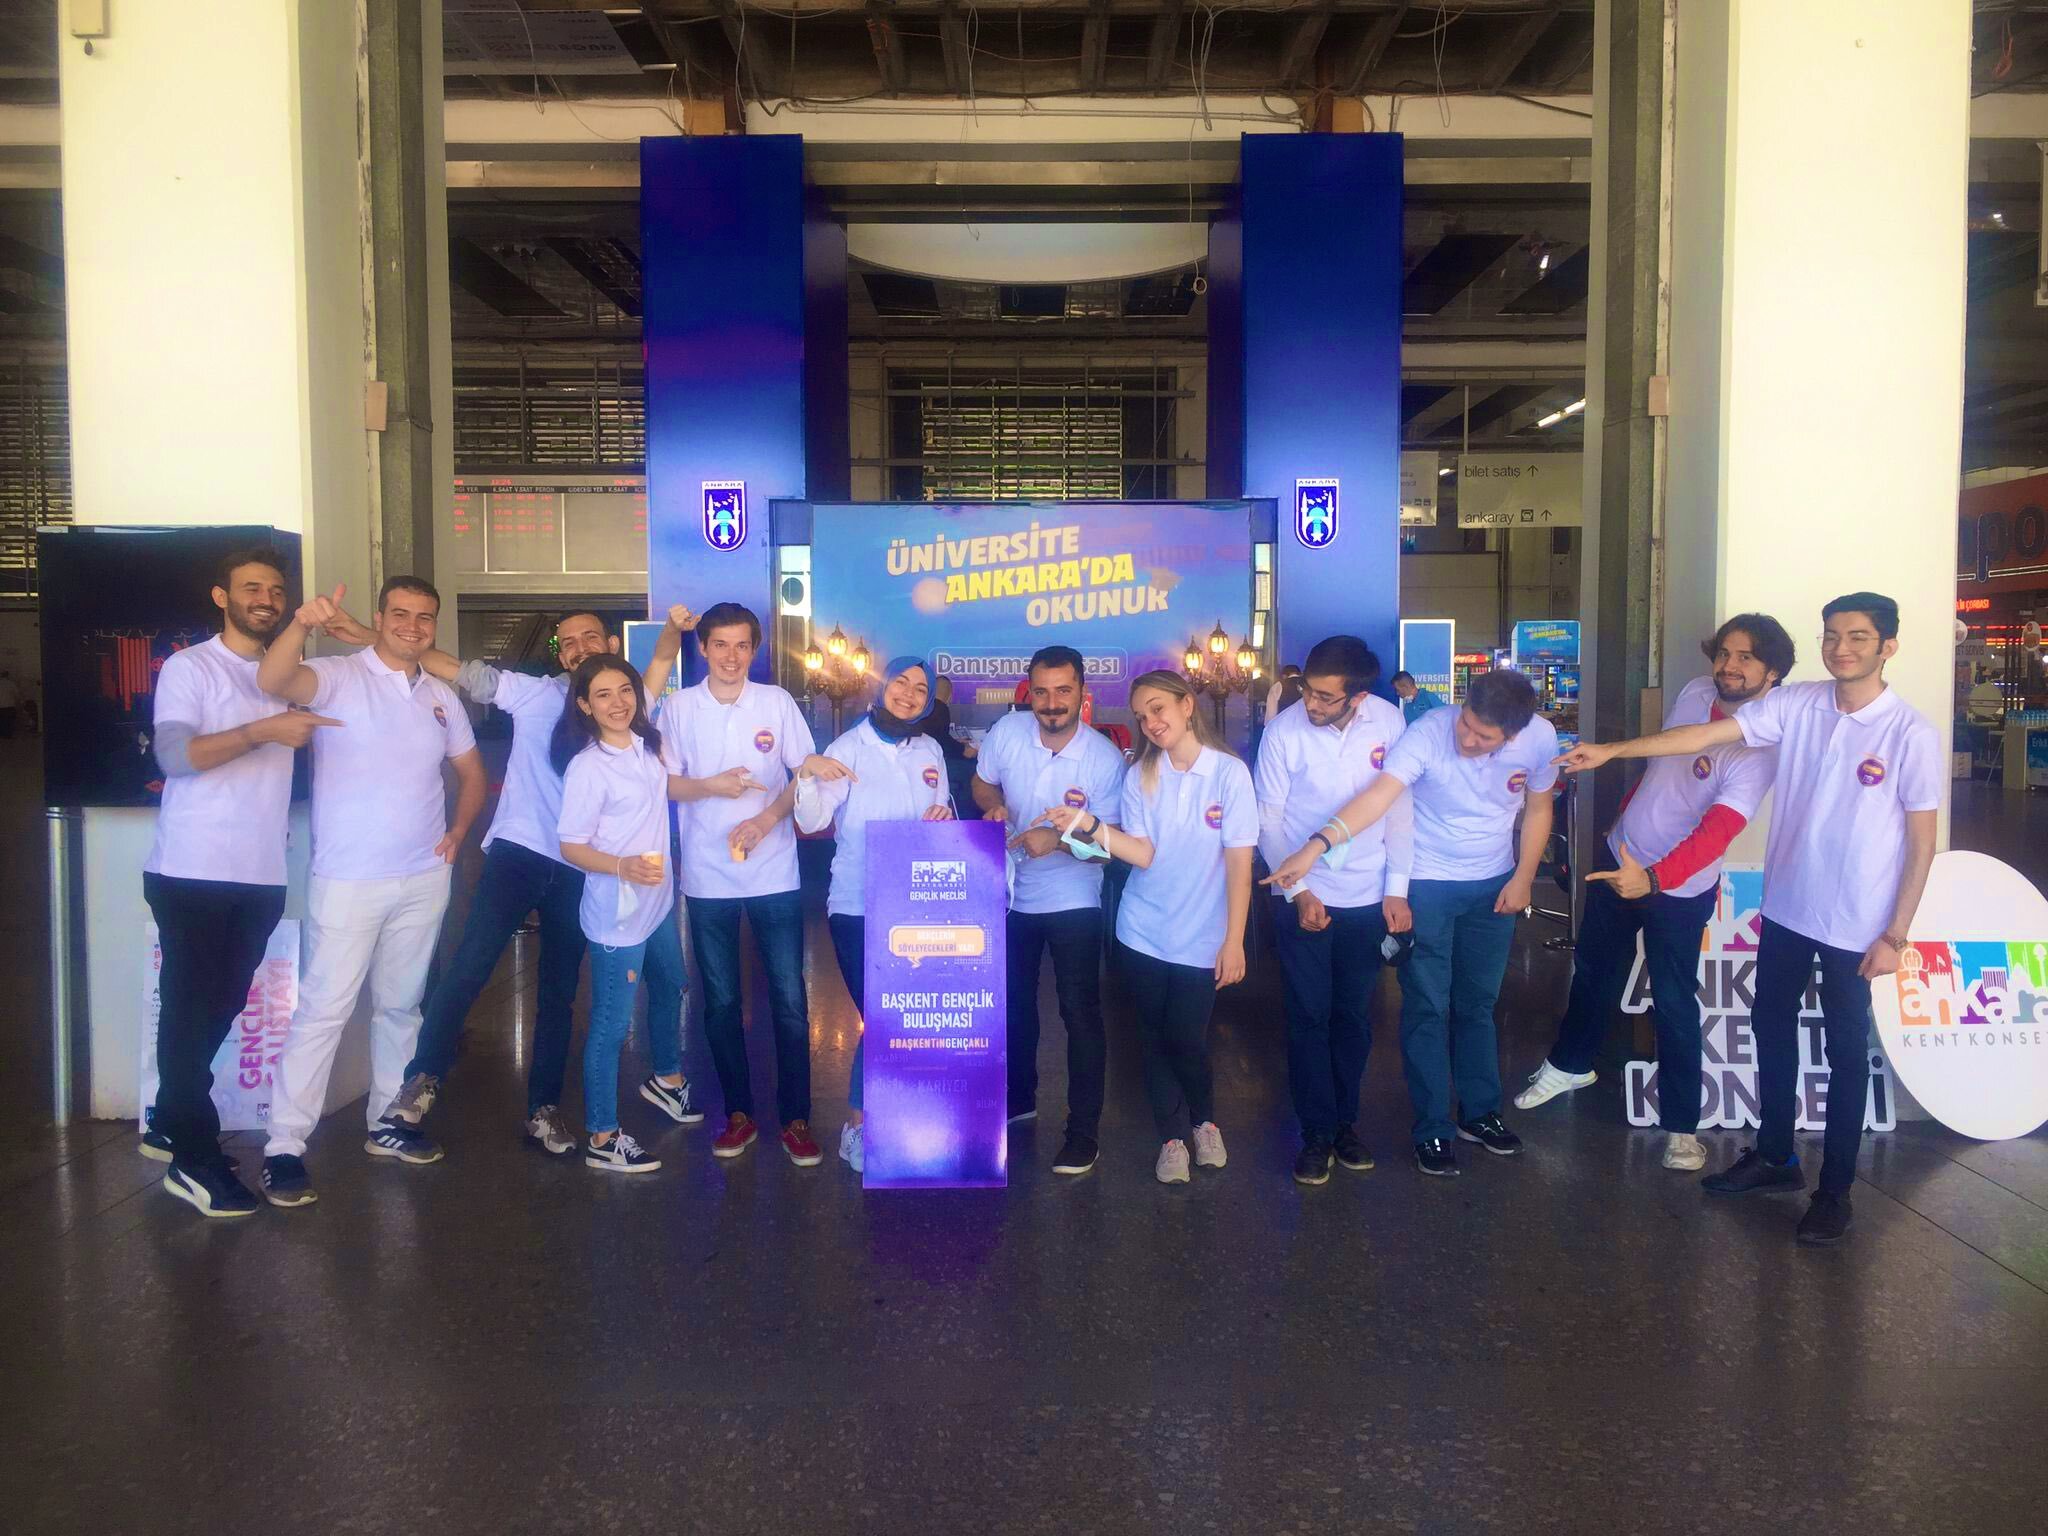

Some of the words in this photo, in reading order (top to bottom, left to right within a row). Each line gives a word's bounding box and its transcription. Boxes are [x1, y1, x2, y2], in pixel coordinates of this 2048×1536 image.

[1464, 465, 1489, 478] bilet
[1492, 466, 1521, 479] satış
[1464, 513, 1515, 526] ankaray
[887, 522, 1080, 576] ÜNİVERSİTE
[945, 553, 1135, 603] ANKARA'DA
[1026, 586, 1169, 627] OKUNUR
[937, 653, 1030, 677] Danışma
[910, 889, 938, 902] GENÇLİK
[940, 889, 966, 900] MECLİSİ
[898, 942, 956, 953] SÖYLEYECEKLERİ
[882, 993, 939, 1012] BAŞKENT
[942, 988, 994, 1011] GENÇLİK
[1902, 1033, 1958, 1048] KENT
[1969, 1031, 2048, 1046] KONSE
